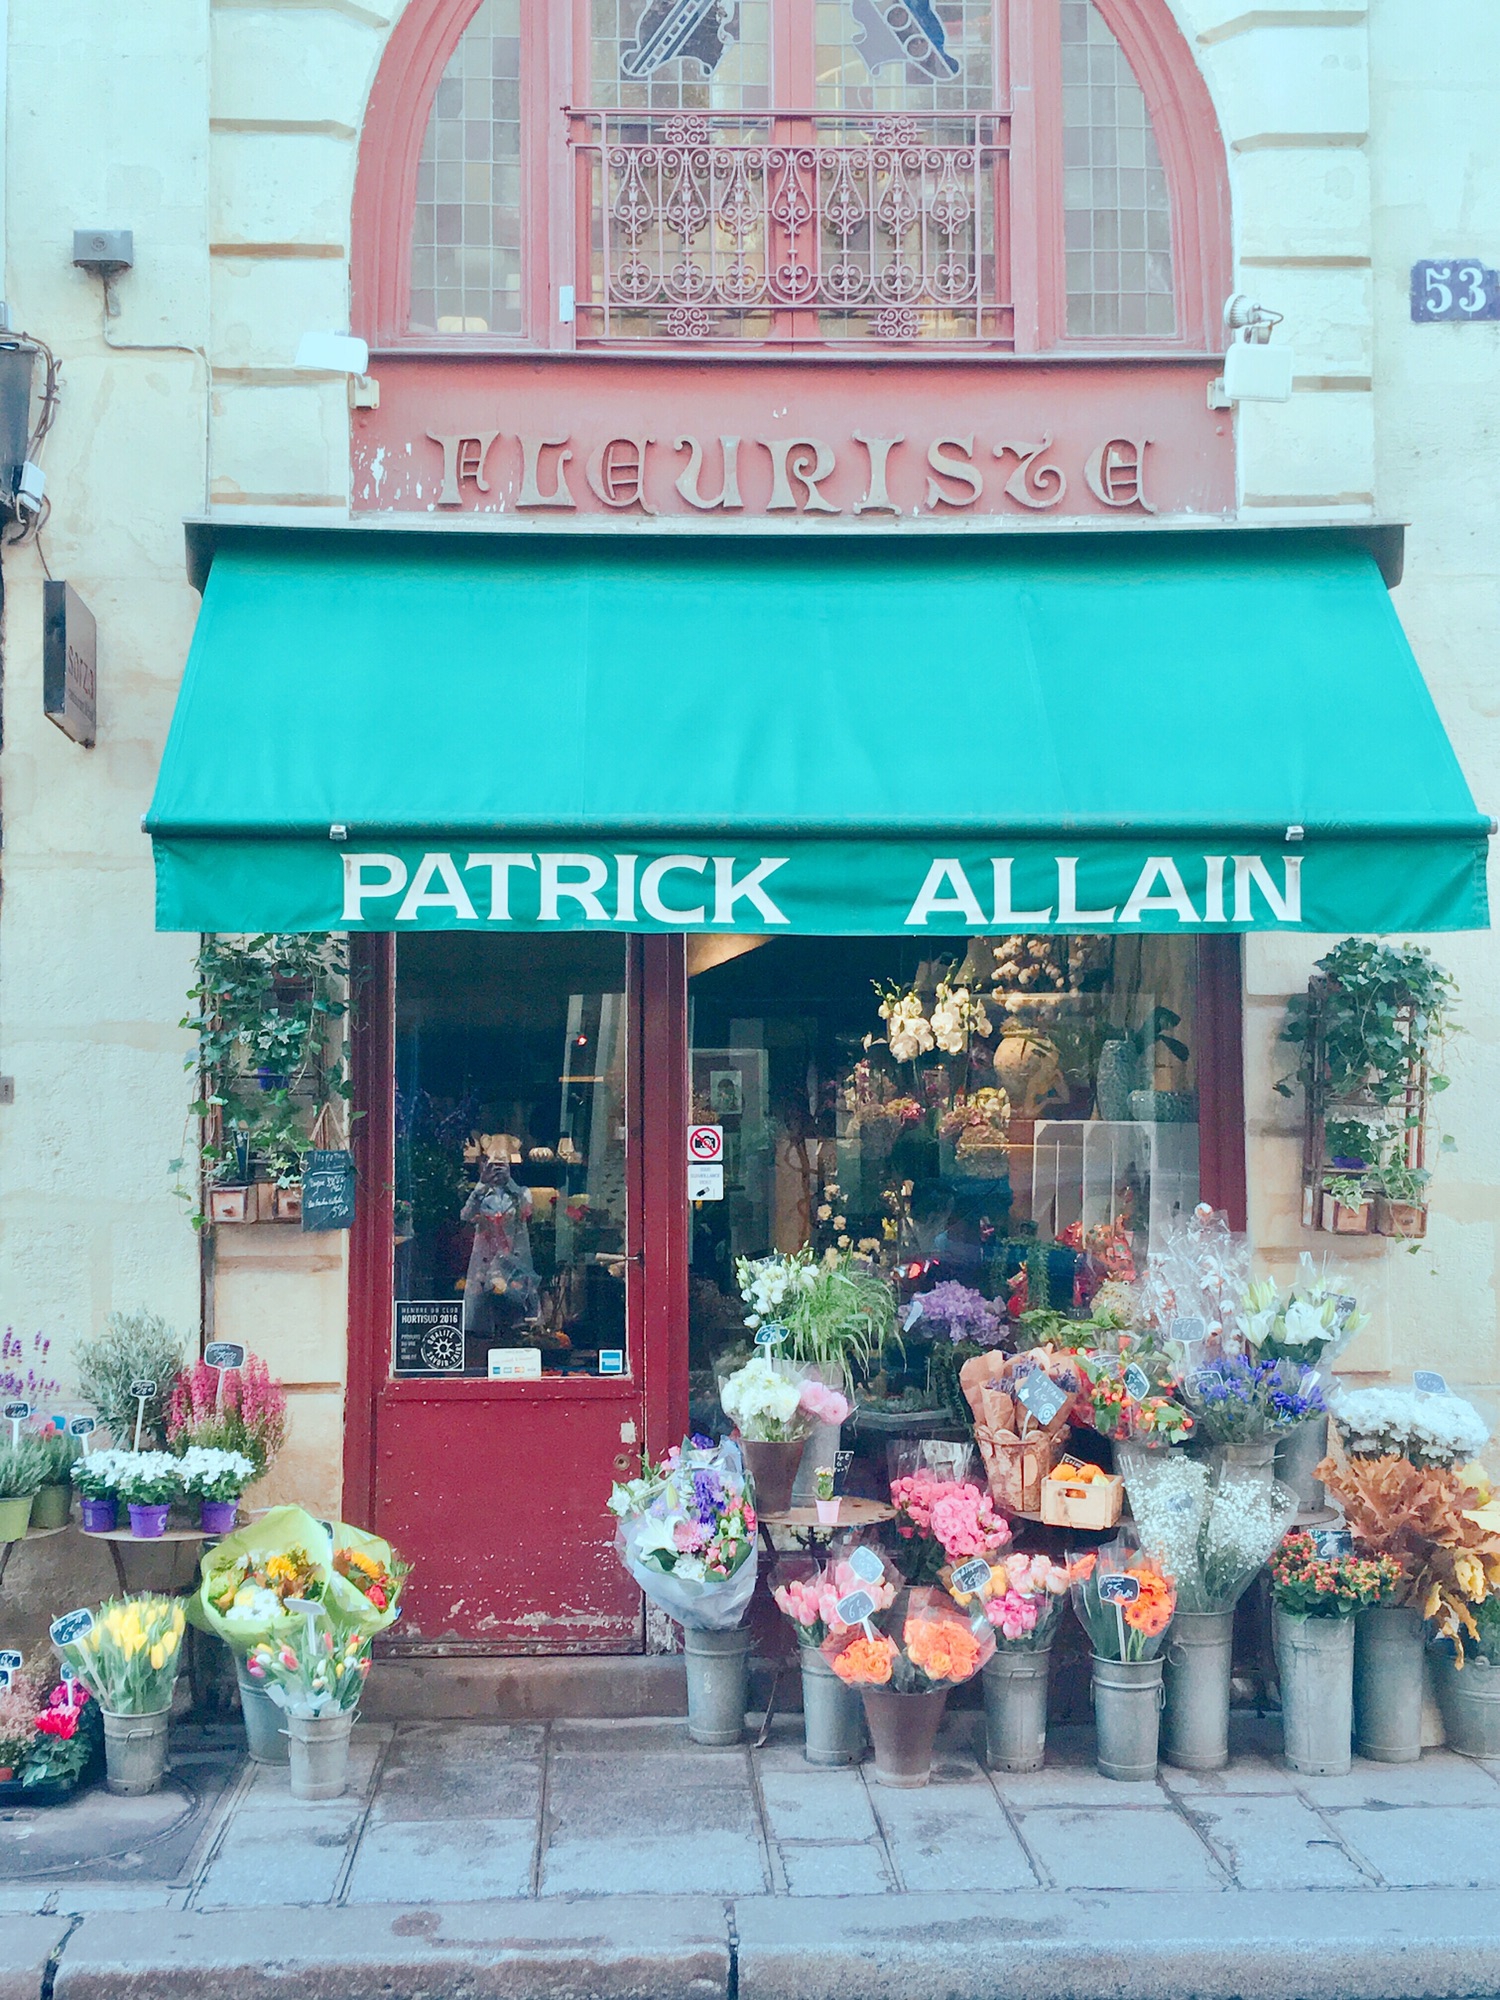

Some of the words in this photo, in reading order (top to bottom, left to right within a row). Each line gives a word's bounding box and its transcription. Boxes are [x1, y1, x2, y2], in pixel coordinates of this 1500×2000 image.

[1426, 267, 1486, 313] 53
[426, 429, 1155, 515] FLEURISTE
[340, 853, 791, 925] PATRICK
[904, 855, 1305, 926] ALLAIN
[401, 1314, 438, 1324] HORTISUD
[439, 1314, 458, 1324] 2016
